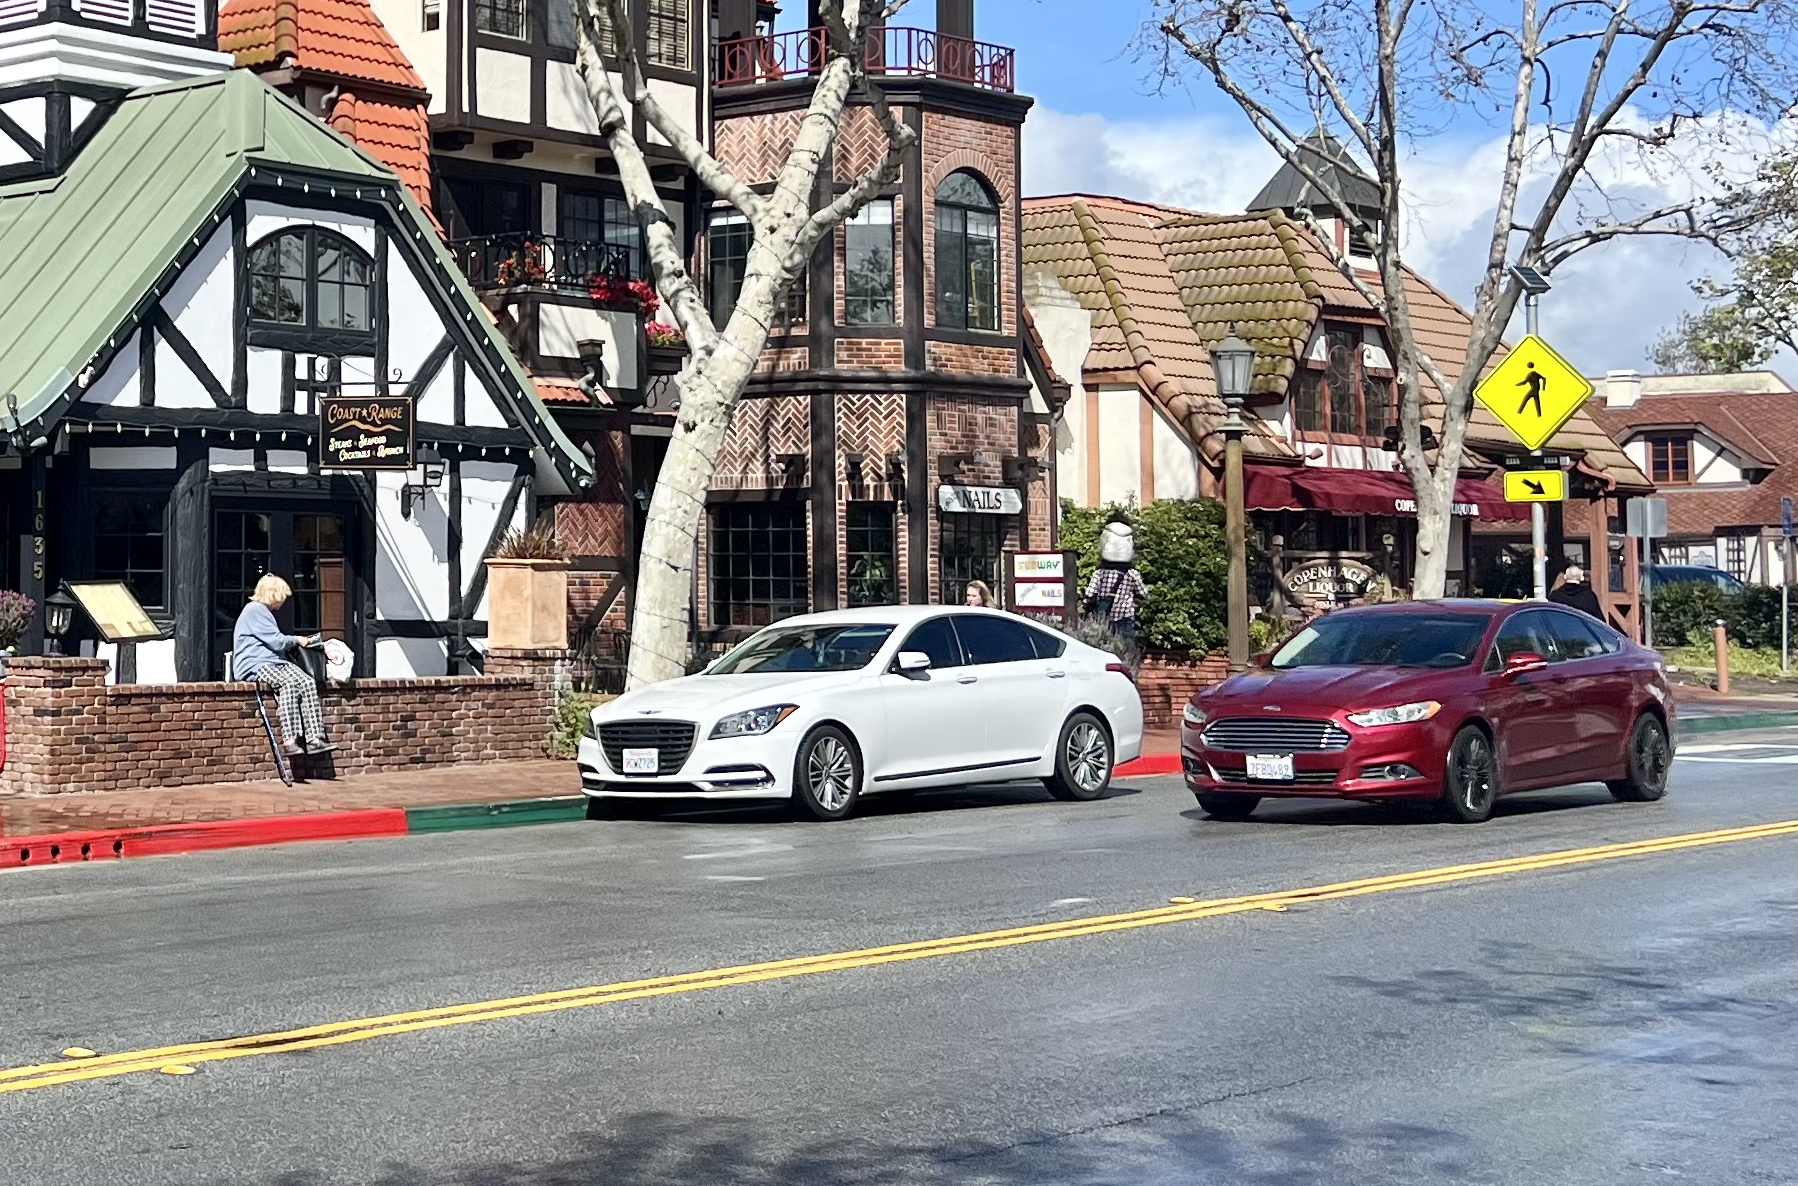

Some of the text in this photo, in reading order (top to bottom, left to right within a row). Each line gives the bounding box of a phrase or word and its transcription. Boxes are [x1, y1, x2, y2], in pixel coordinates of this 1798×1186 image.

[962, 489, 1002, 510] NAILS
[1451, 502, 1479, 516] LIQUOR
[33, 490, 44, 580] 1635
[1017, 560, 1060, 570] SUBWAY
[1308, 582, 1354, 595] LIQUOR
